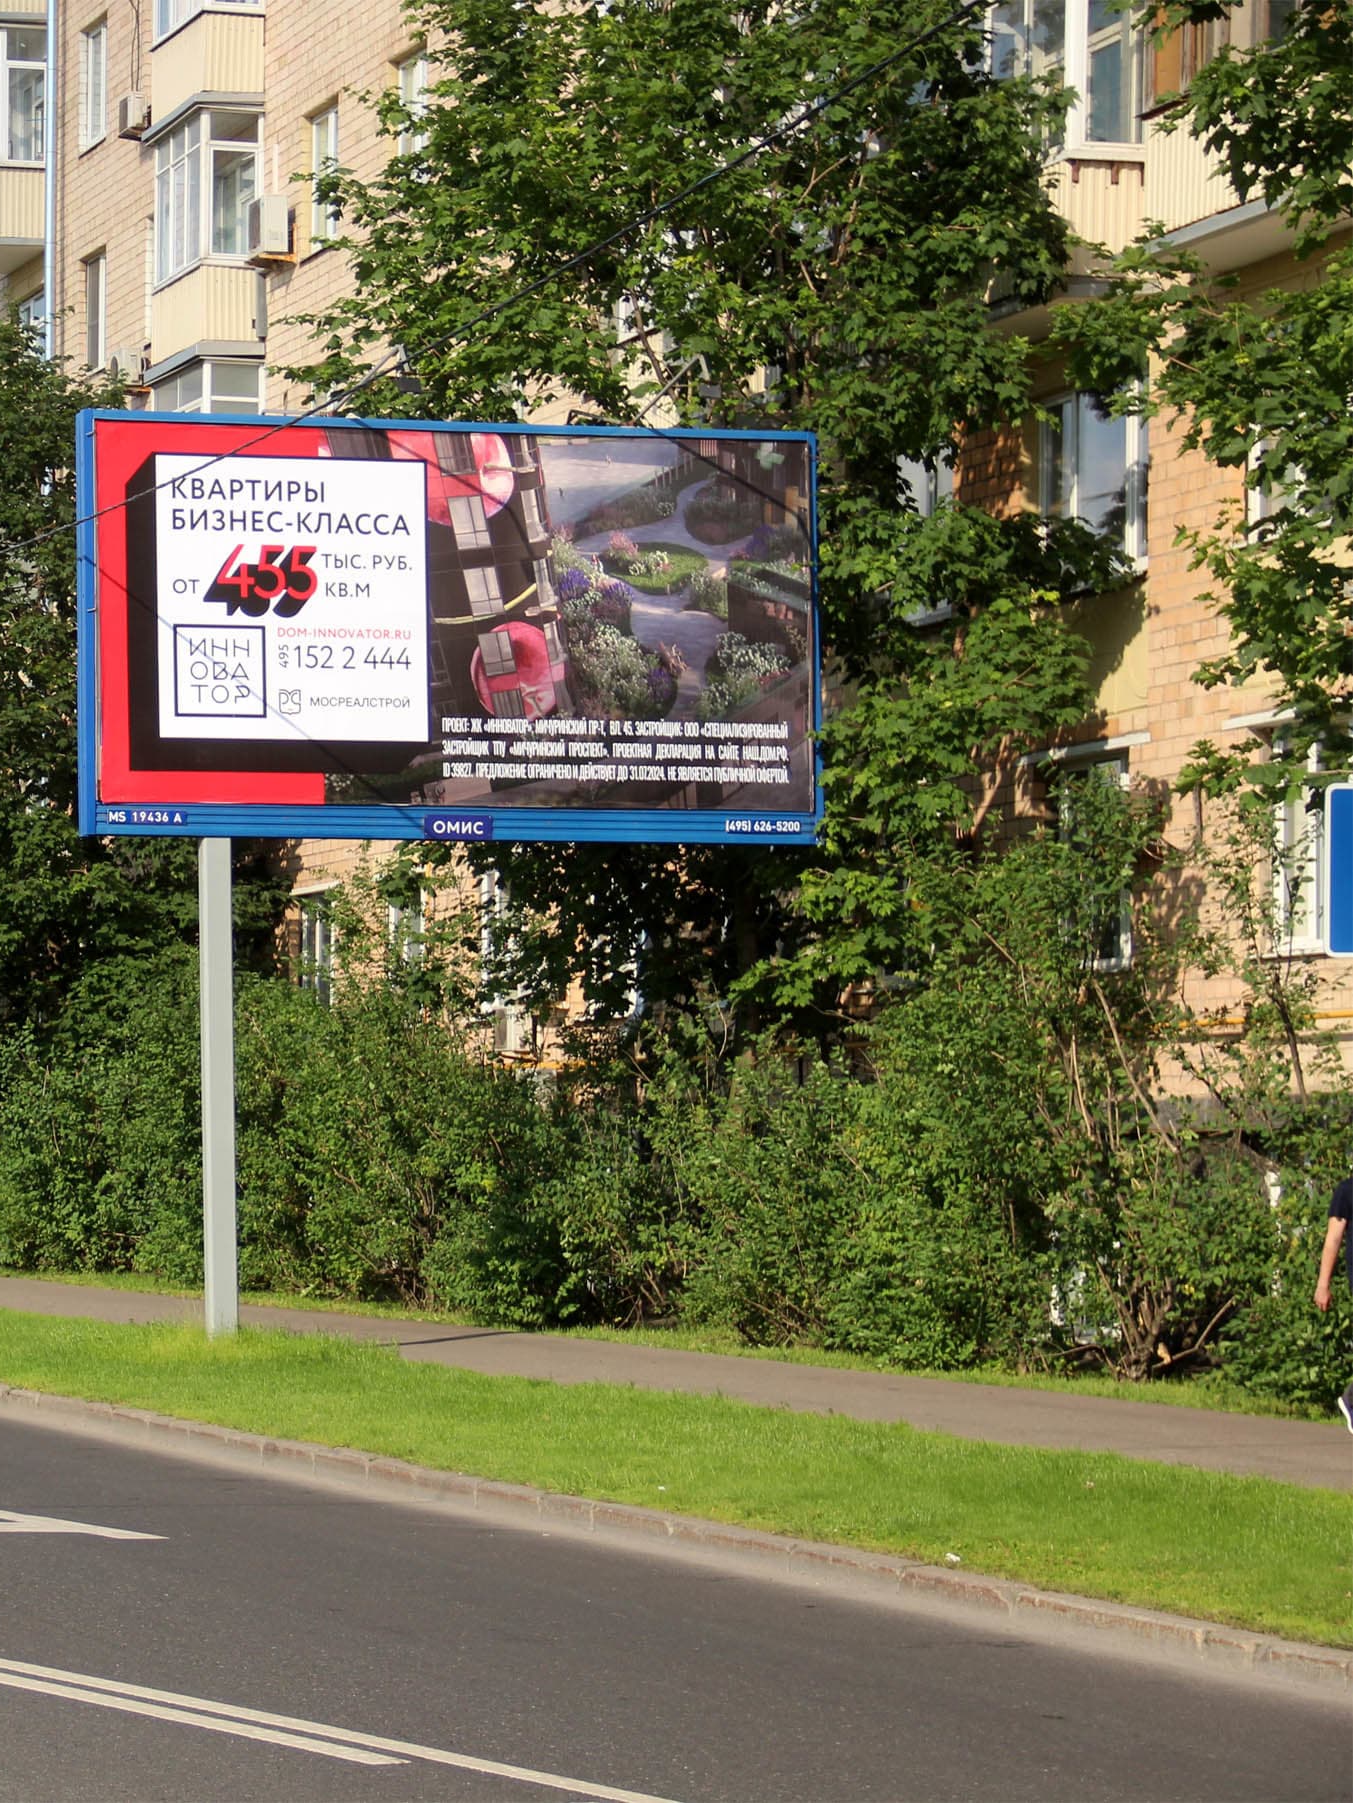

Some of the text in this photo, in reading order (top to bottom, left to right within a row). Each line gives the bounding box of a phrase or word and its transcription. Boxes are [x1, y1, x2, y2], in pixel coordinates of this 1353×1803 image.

[171, 477, 325, 503] КВАРТИРЫ
[171, 508, 410, 536] БИЗНЕС-КЛАССА
[172, 543, 370, 600] ОТ 455 КВ.М
[321, 553, 413, 571] ТЫС. РУБ.
[277, 627, 411, 640] DOM-INNOVATOR.RU
[189, 638, 250, 658] ИНН
[278, 644, 411, 670] 495 152 2 444
[190, 661, 250, 681] ОВА
[190, 684, 251, 704] ТОР
[309, 695, 411, 708] МОСРЕАЛСТРОЙ
[441, 717, 470, 733] ПРОЕКТ:
[470, 717, 483, 733] ЖК
[535, 716, 587, 736] МИЧУРИНСКИЙ
[588, 719, 606, 736] ПР-Т,
[609, 720, 622, 736] ВЛ.
[623, 720, 634, 736] 45.
[635, 718, 683, 739] ЗАСТРОЙЩИК:
[684, 721, 700, 737] ООО
[700, 721, 788, 740] «СПЕЦИАЛИЗИРОВАННЫЙ
[442, 737, 489, 757] ЗАСТРОЙЩИК
[492, 741, 506, 758] ТПУ
[509, 738, 566, 758] «МИЧУРИНСКИЙ
[612, 743, 652, 758] ПРОЕКТНАЯ
[655, 744, 702, 762] ДЕКЛАРАЦИЯ
[705, 744, 716, 760] НА
[718, 742, 740, 760] САЙТЕ
[442, 762, 451, 777] ID
[475, 763, 527, 781] ПРЕДЛОЖЕНИЕ
[527, 764, 572, 779] ОГРАНИЧЕНО
[573, 764, 579, 779] И
[579, 762, 617, 782] ДЕЙСТВУЕТ
[617, 765, 628, 782] ДО
[667, 766, 677, 781] НЕ
[677, 766, 713, 782] ЯВЛЯЕТСЯ
[714, 764, 756, 784] ПУБЛИЧНОЙ
[108, 811, 183, 824] MS 19436 A
[433, 820, 484, 835] ОМИС
[725, 819, 801, 833] (495) 626-5200
